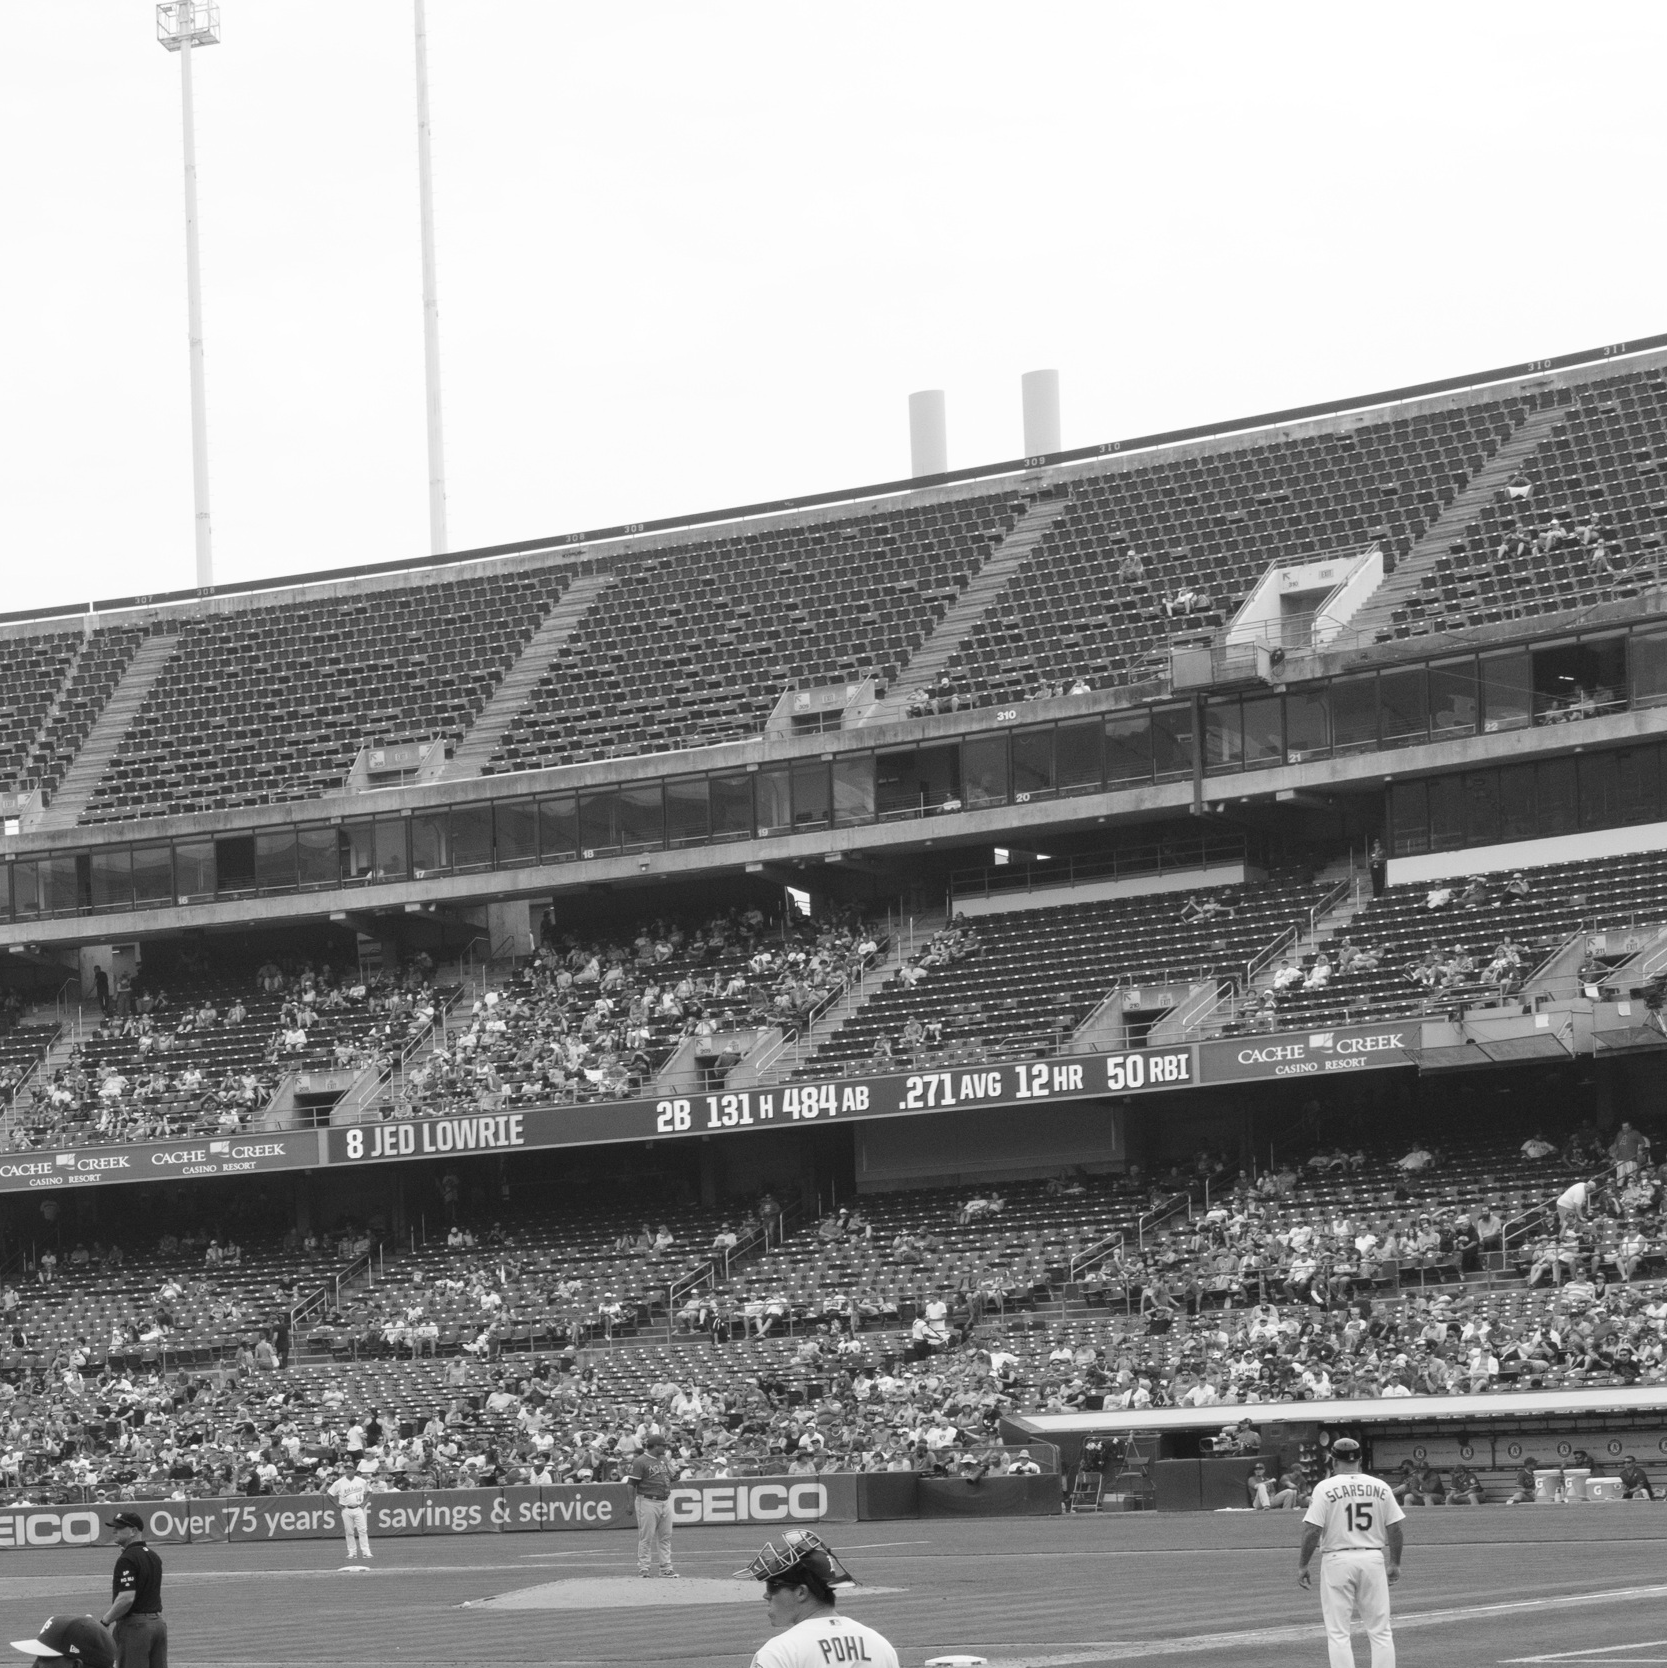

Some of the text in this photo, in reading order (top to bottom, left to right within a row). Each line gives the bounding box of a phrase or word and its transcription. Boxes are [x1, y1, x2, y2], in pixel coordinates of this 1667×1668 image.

[997, 710, 1016, 721] 310
[1238, 1033, 1405, 1064] CACHE CREEK
[1275, 1057, 1367, 1075] CASINO RESORT
[347, 1054, 1189, 1158] 8 JED LOWRIE 2B 131 H 484 AB .271 AVG 12 HR 50 RBI
[1325, 1484, 1388, 1503] SCARSONE
[150, 1511, 215, 1536] Over
[222, 1506, 257, 1534] 75
[264, 1505, 335, 1537] years
[379, 1499, 482, 1531] savings
[490, 1497, 512, 1524] &
[519, 1493, 612, 1522] service
[670, 1480, 828, 1525] GEICO
[1345, 1502, 1373, 1532] 15
[817, 1636, 872, 1665] POHL
